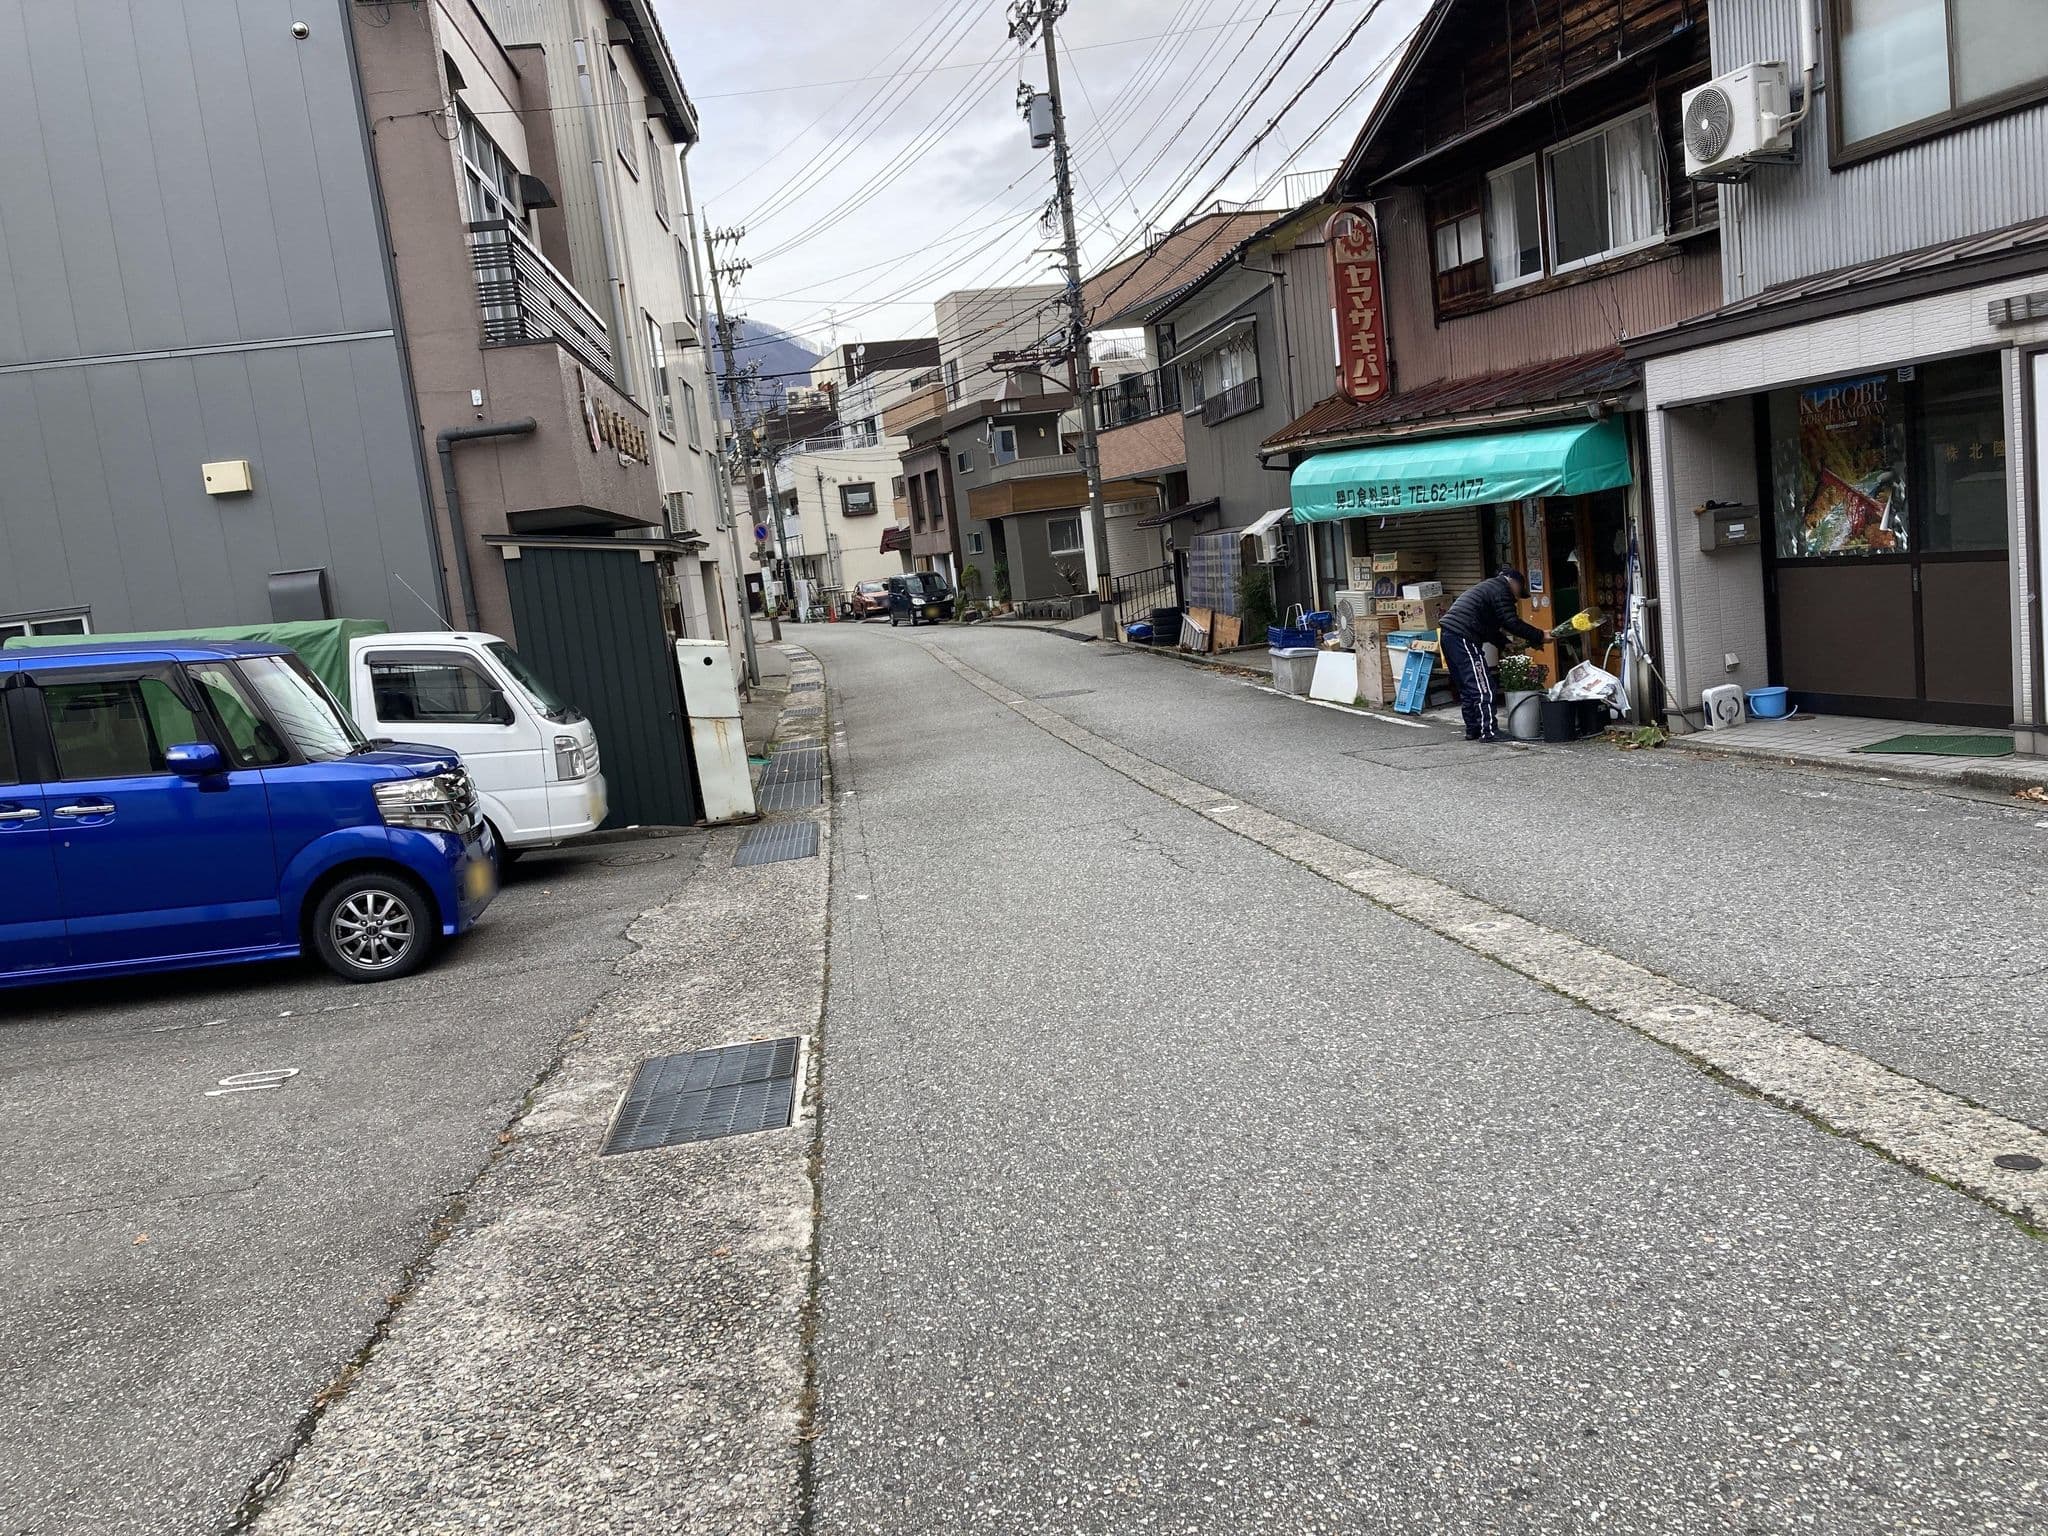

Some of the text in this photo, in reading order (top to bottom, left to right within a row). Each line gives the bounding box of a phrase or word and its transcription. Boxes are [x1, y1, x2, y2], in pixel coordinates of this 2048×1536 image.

[1344, 264, 1381, 397] ヤマザキパン
[1799, 379, 1888, 415] KUROBE
